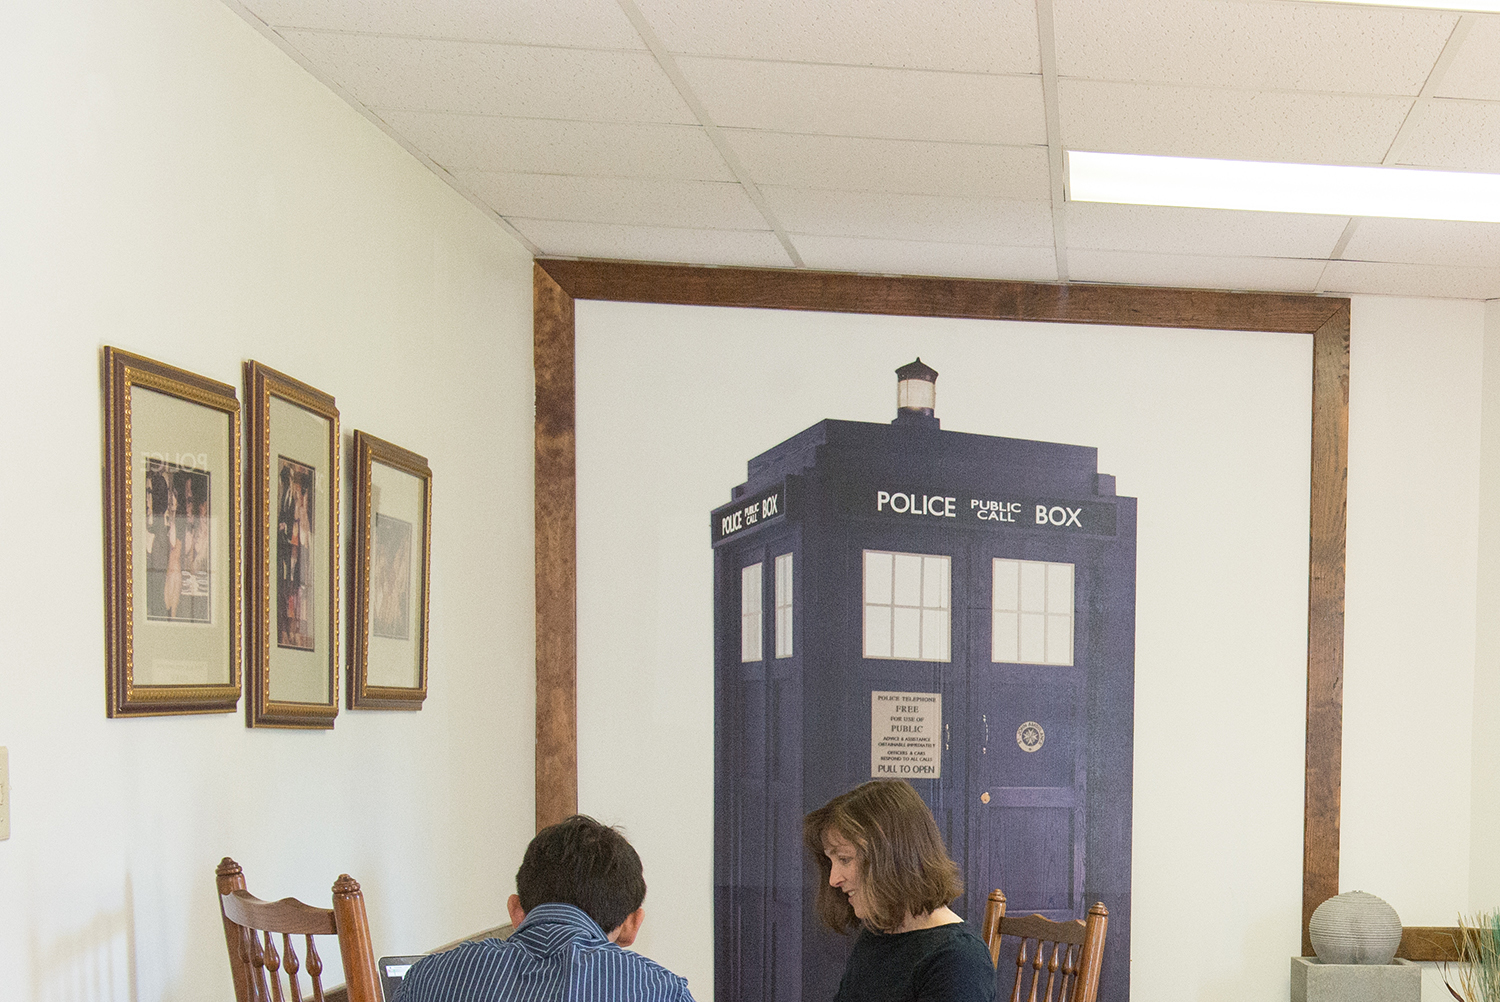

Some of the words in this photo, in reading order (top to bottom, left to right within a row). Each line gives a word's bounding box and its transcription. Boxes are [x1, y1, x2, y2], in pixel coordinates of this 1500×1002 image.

[744, 502, 760, 517] PUBLIC
[762, 493, 778, 519] BOX
[877, 490, 956, 518] POLICE
[970, 499, 1022, 513] PUBLIC
[722, 510, 743, 536] POLICE
[745, 513, 758, 526] CALL
[976, 510, 1016, 523] CALL
[1035, 504, 1083, 528] BOX
[895, 705, 919, 713] FREE
[891, 724, 924, 733] PUBLIC
[877, 764, 897, 773] PULL
[899, 764, 911, 774] TO
[912, 765, 935, 774] OPEN
